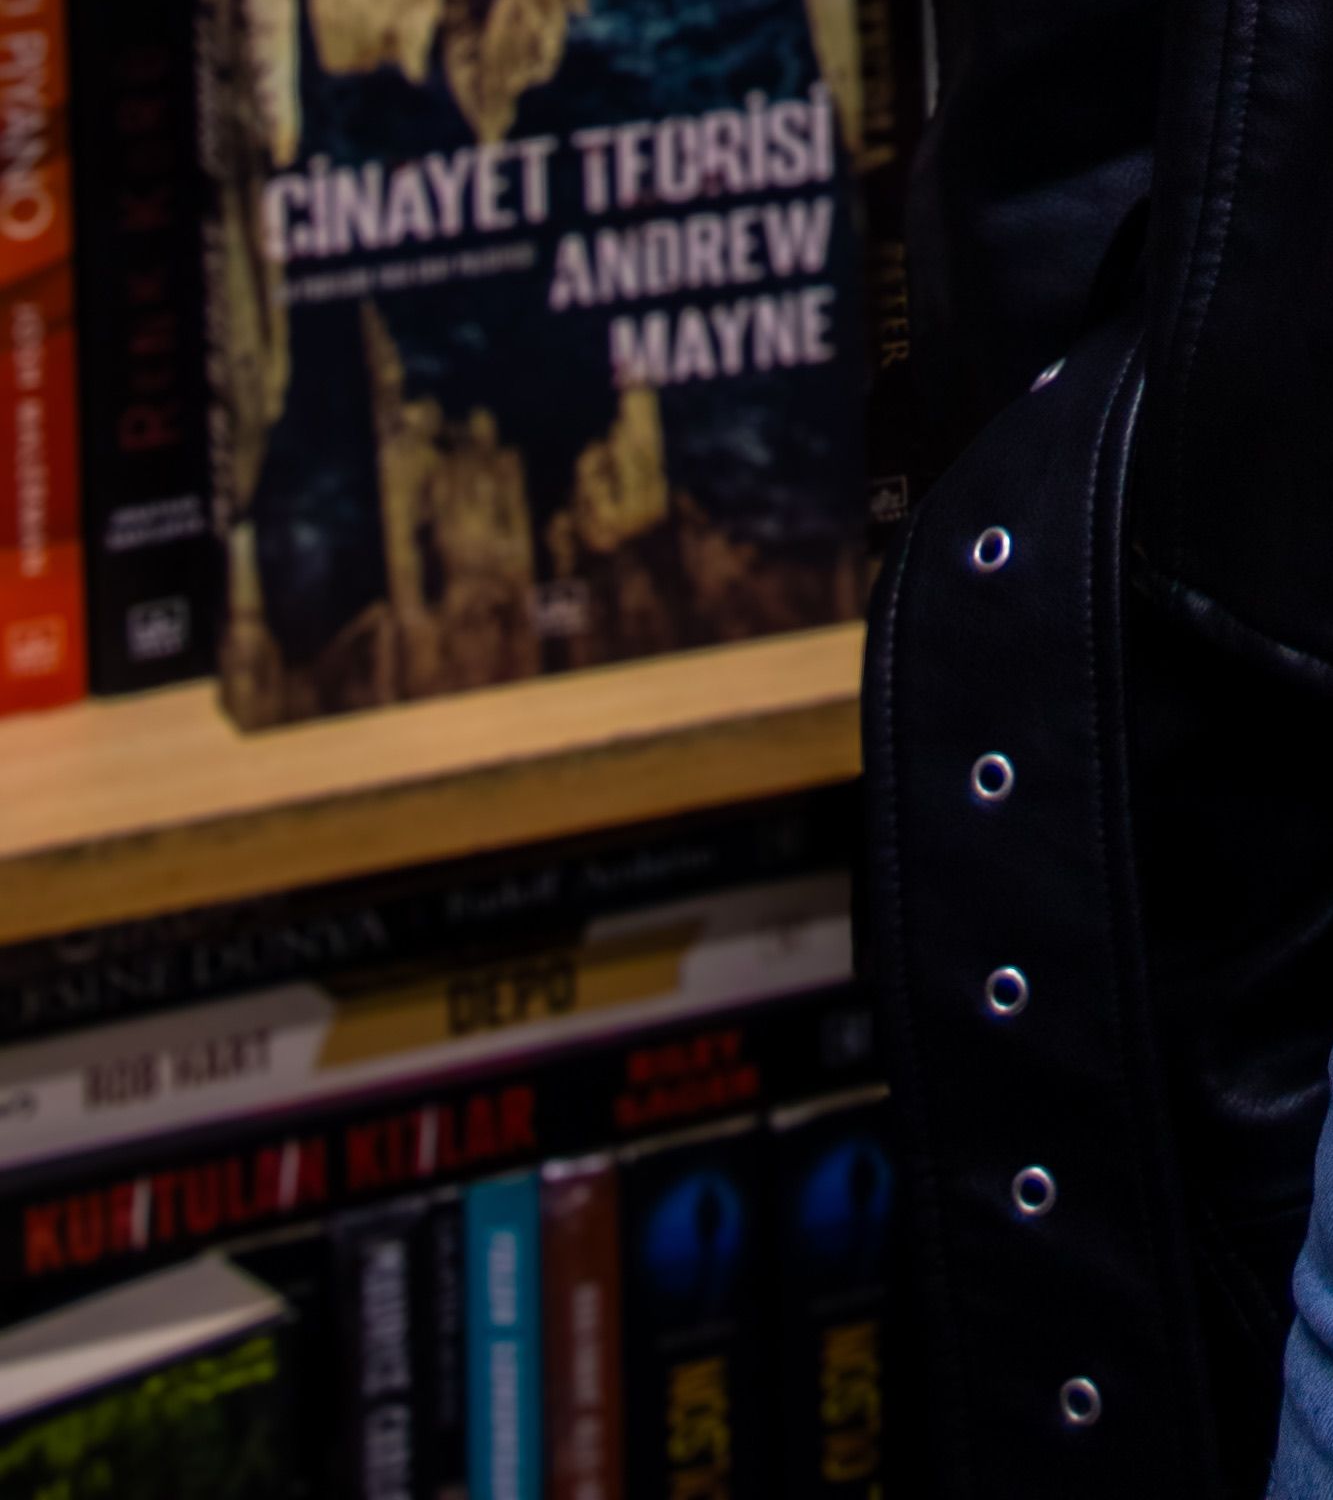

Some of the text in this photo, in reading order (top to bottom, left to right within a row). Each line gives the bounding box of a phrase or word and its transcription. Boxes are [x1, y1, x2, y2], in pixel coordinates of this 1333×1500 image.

[262, 86, 834, 262] CİNAYET TEORİSİ
[551, 199, 833, 312] ANDREW
[612, 286, 834, 388] MAYNE
[449, 963, 581, 1034] DEPO
[26, 1084, 539, 1277] KURTULAN KIZLAR
